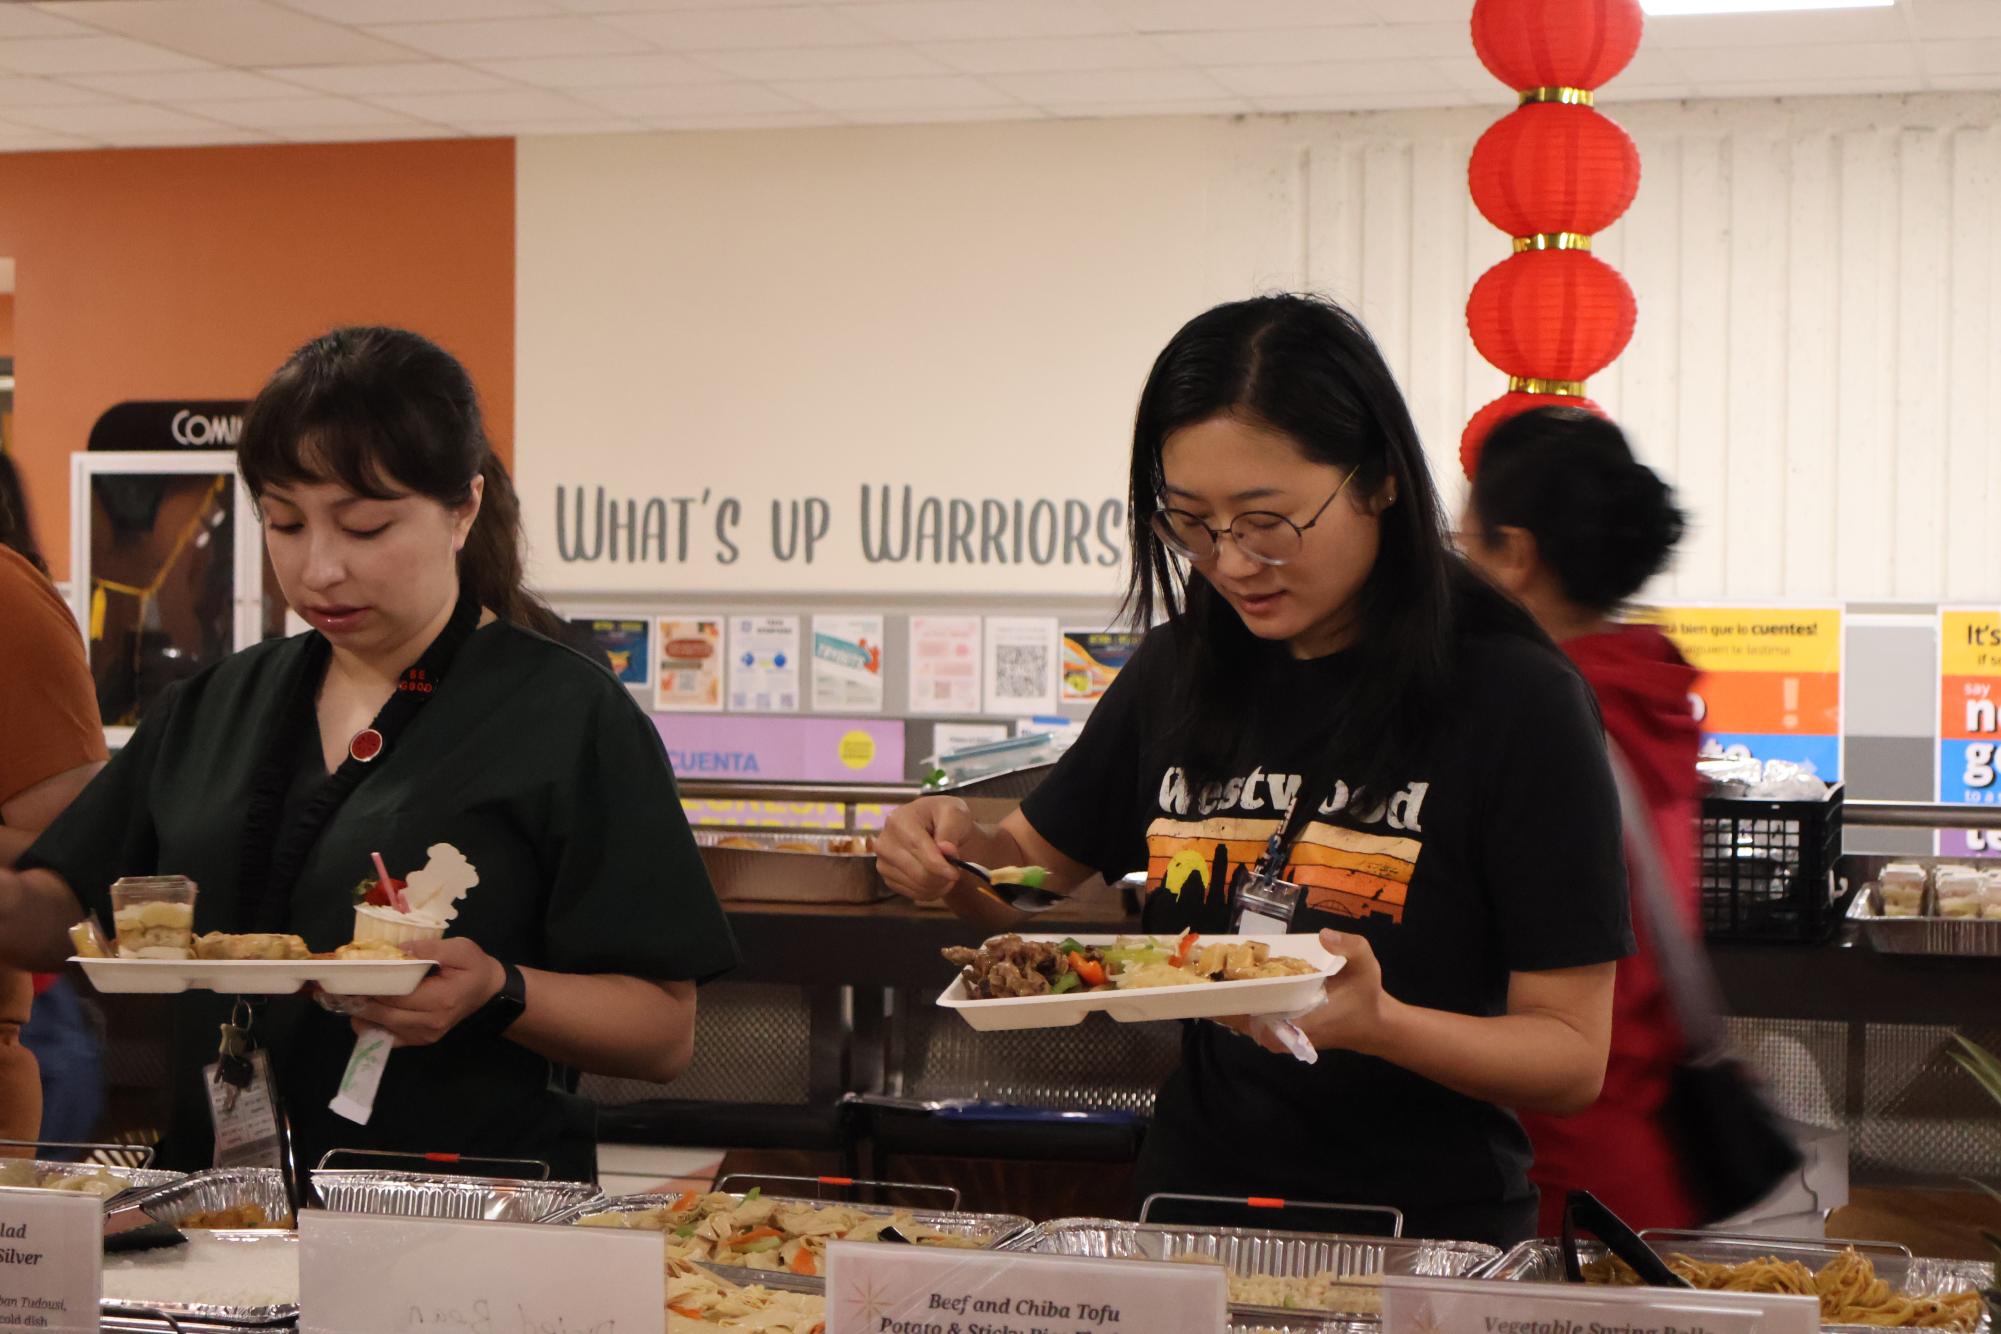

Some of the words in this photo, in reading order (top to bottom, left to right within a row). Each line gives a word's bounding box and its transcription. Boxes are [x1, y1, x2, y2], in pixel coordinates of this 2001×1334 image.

[556, 485, 741, 565] WHAT'S
[771, 497, 830, 564] UP
[860, 484, 1123, 566] WARRIORS
[1681, 623, 1707, 634] bien
[1711, 625, 1734, 636] que
[1752, 622, 1817, 635] cuentes!
[1966, 699, 2001, 733] n
[24, 1315, 48, 1327] dish
[928, 1293, 971, 1315] Beef
[973, 1298, 1010, 1314] and
[1016, 1299, 1071, 1318] Chiba
[1077, 1303, 1120, 1326] Tofu
